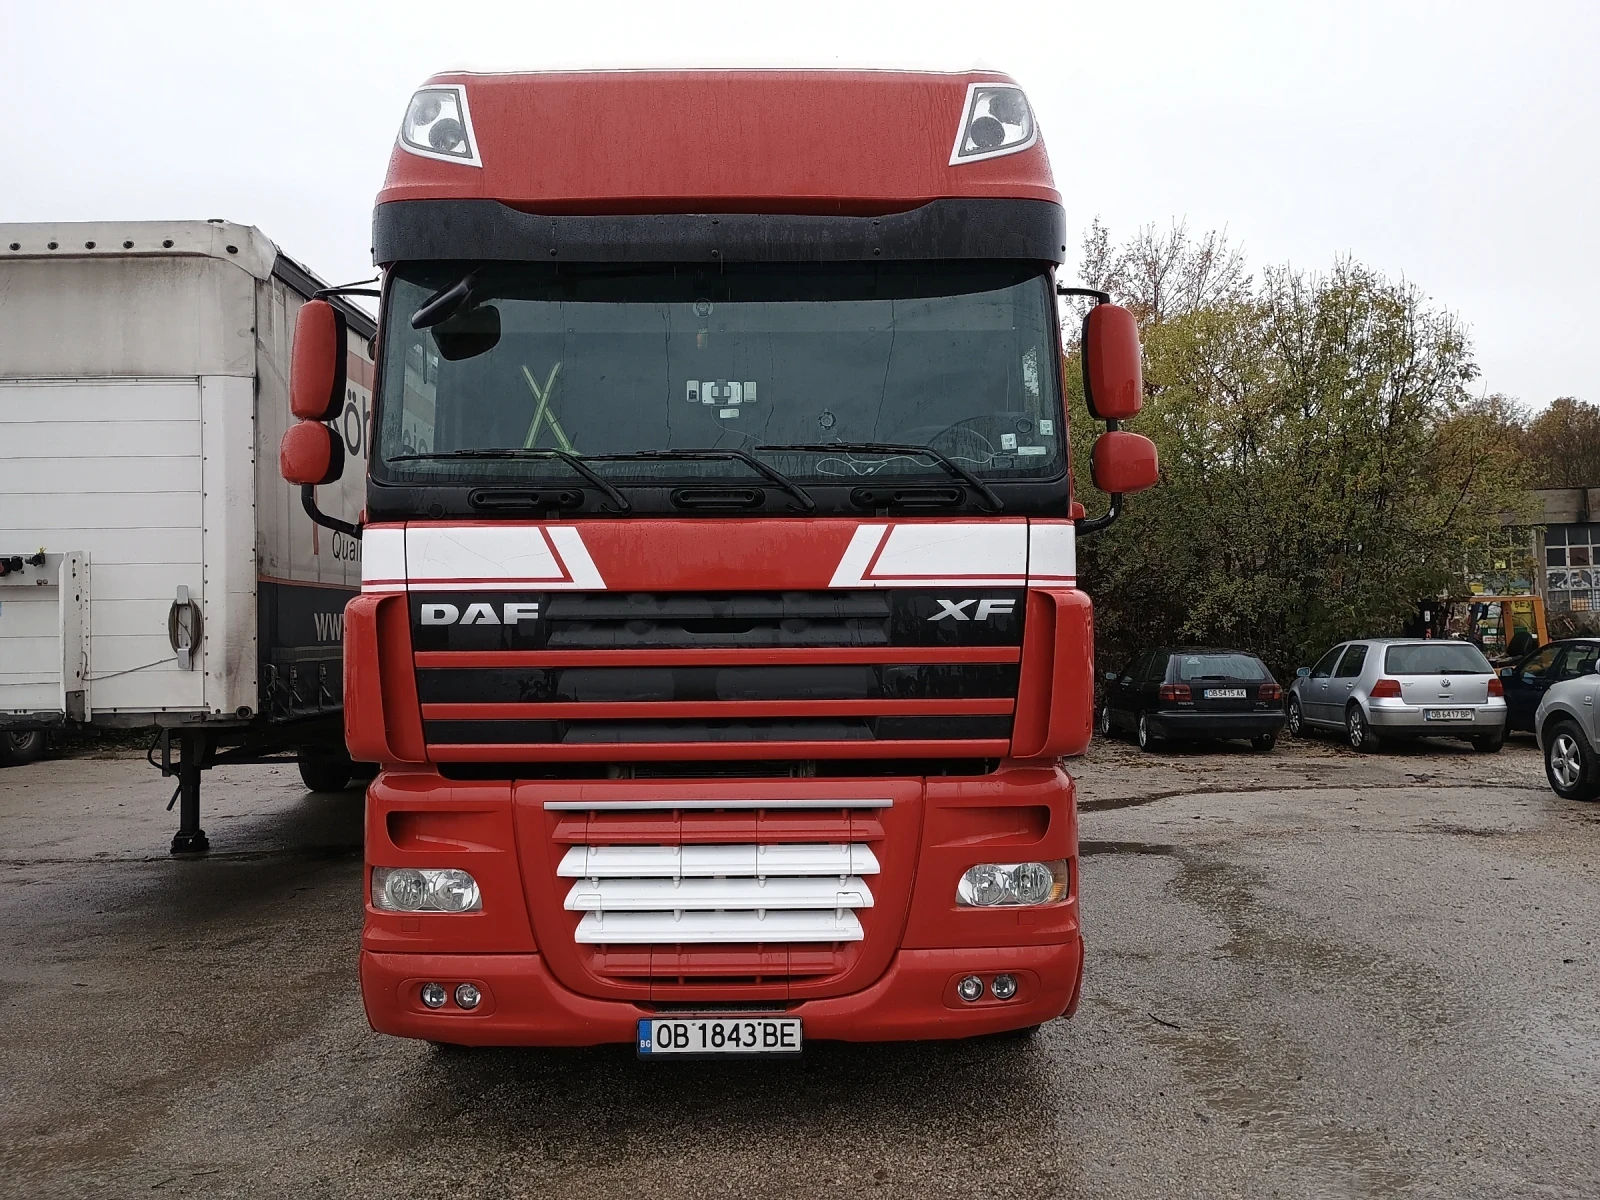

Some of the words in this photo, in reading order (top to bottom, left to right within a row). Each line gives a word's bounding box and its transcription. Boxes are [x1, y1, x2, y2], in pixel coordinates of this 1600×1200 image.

[421, 603, 539, 625] DAF
[927, 599, 1016, 621] XF
[1218, 689, 1235, 697] 5415
[1236, 689, 1245, 697] AK
[1442, 710, 1459, 718] 6417
[656, 1023, 690, 1049] OB
[698, 1022, 757, 1048] 1843
[763, 1022, 796, 1048] BE
